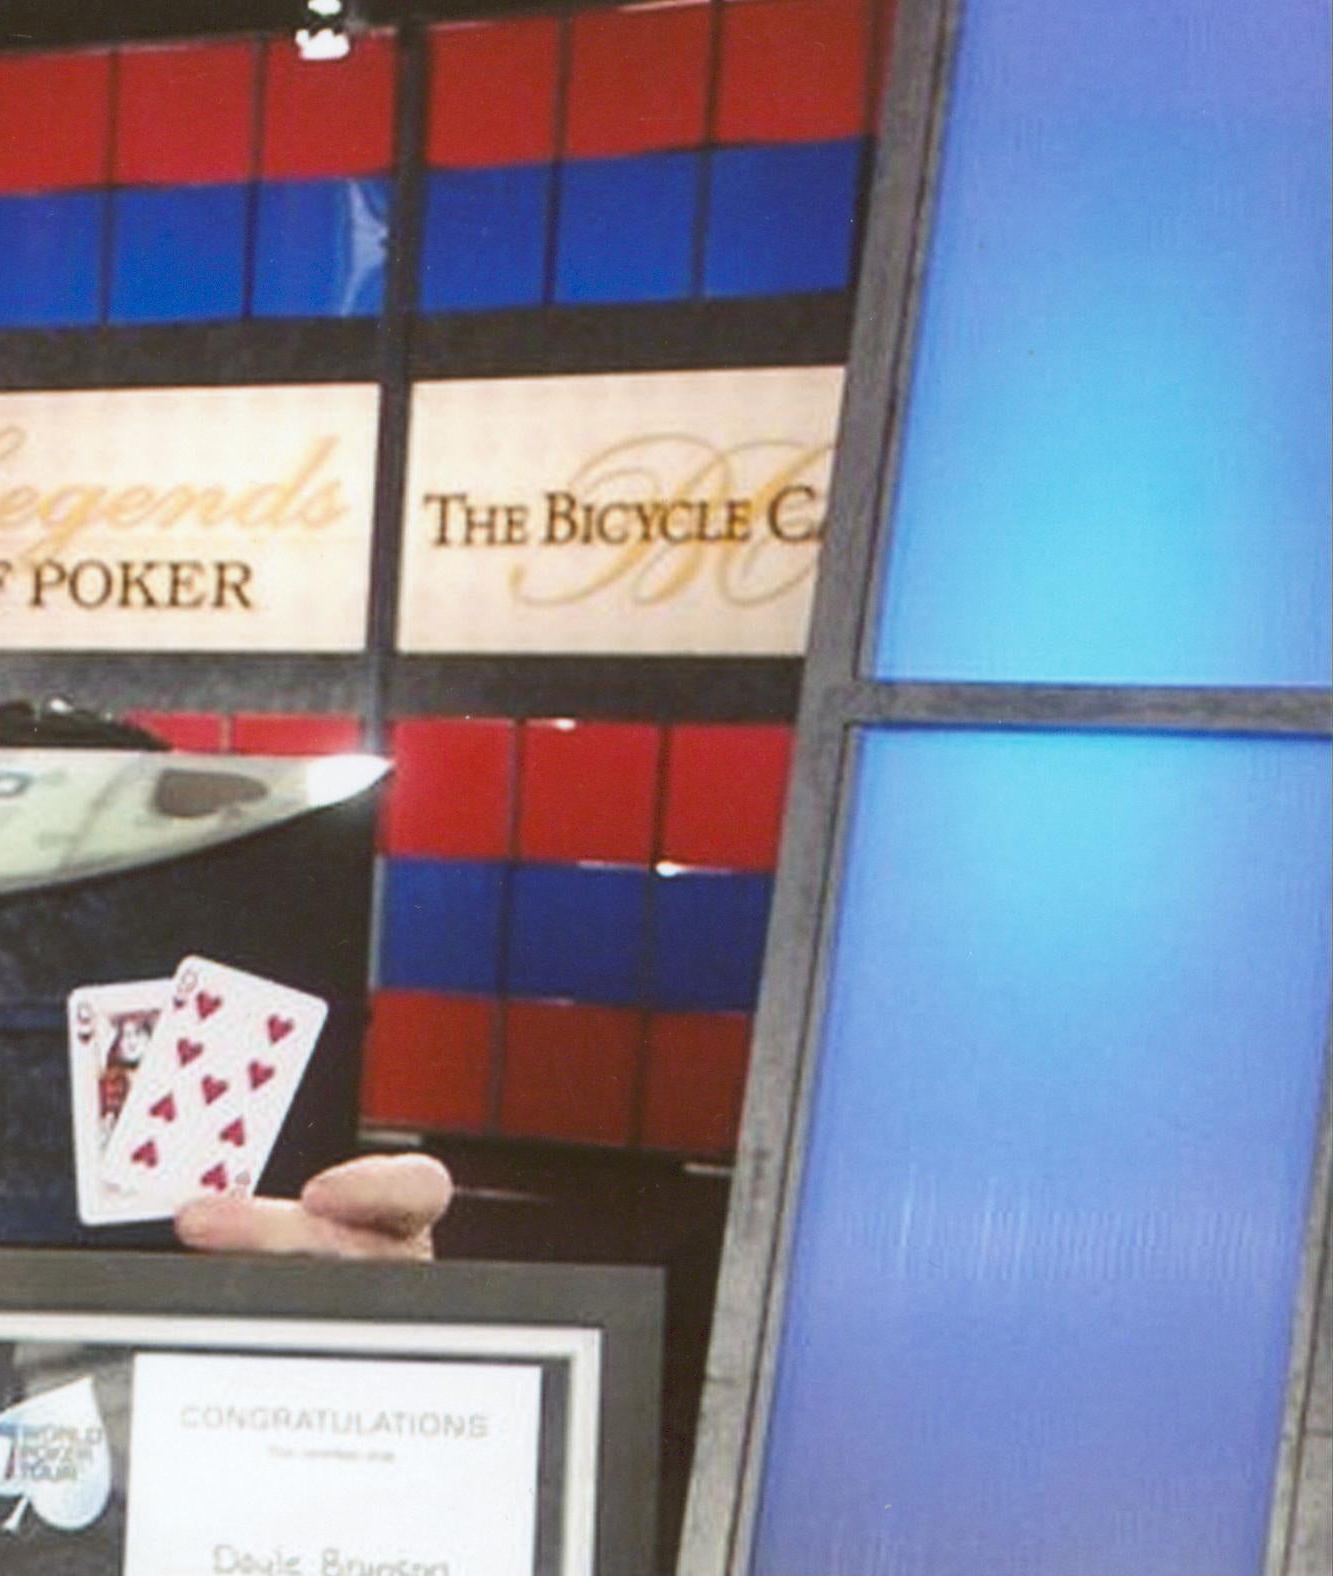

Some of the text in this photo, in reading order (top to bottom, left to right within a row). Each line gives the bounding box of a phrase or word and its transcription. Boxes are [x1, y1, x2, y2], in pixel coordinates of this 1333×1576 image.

[425, 484, 829, 546] THE BICYCLE C
[31, 558, 256, 609] POKER
[179, 1404, 491, 1440] CONGRATULATIONS
